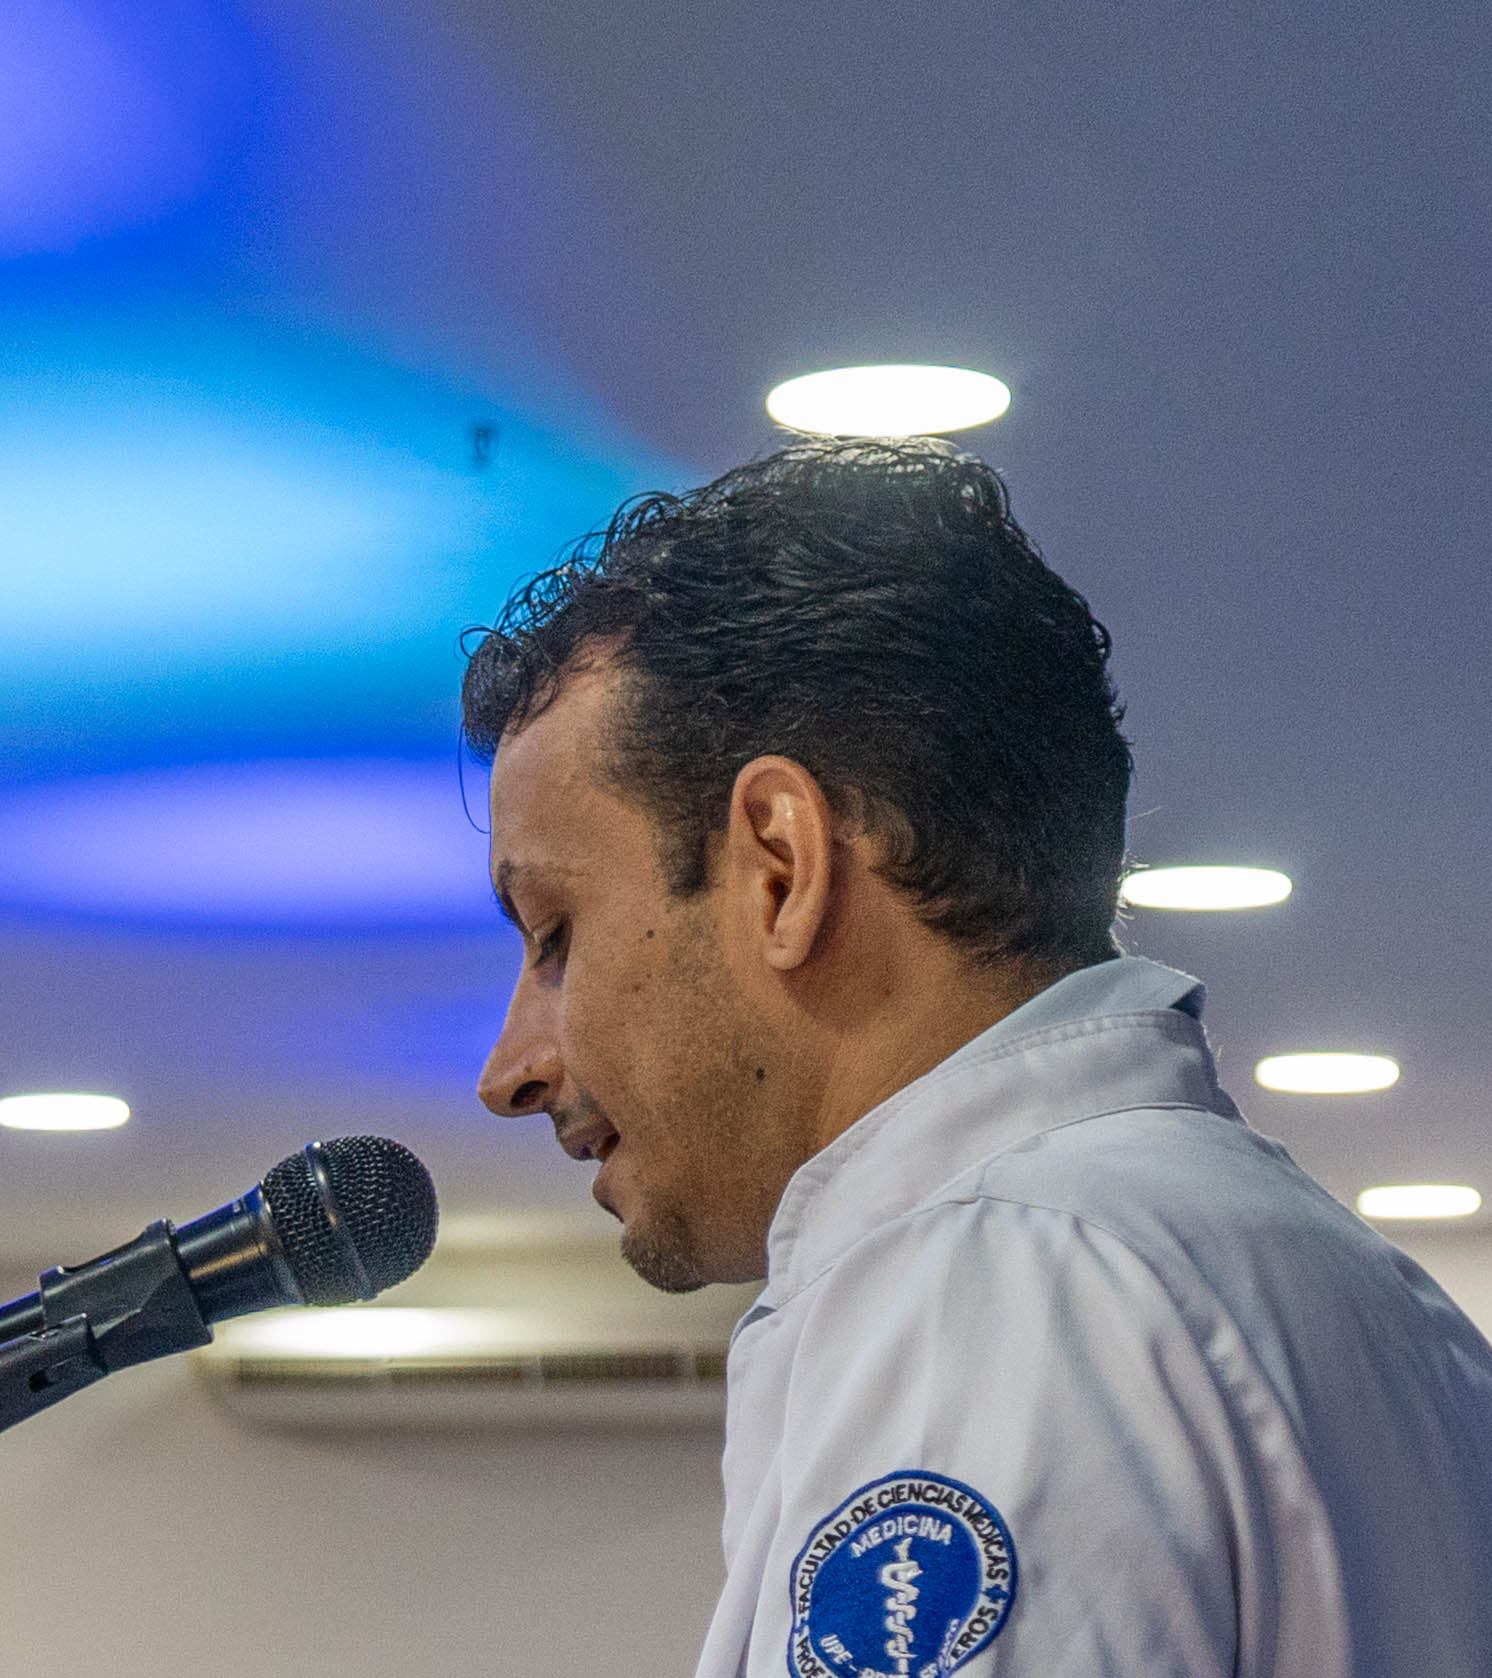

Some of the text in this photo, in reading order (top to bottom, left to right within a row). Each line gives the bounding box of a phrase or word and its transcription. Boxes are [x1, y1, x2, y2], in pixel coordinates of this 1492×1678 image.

[798, 1483, 1009, 1615] FACULTAD DE CIENCIAS MEDICAS
[851, 1515, 953, 1558] MEDICINA
[820, 1634, 853, 1665] UPE
